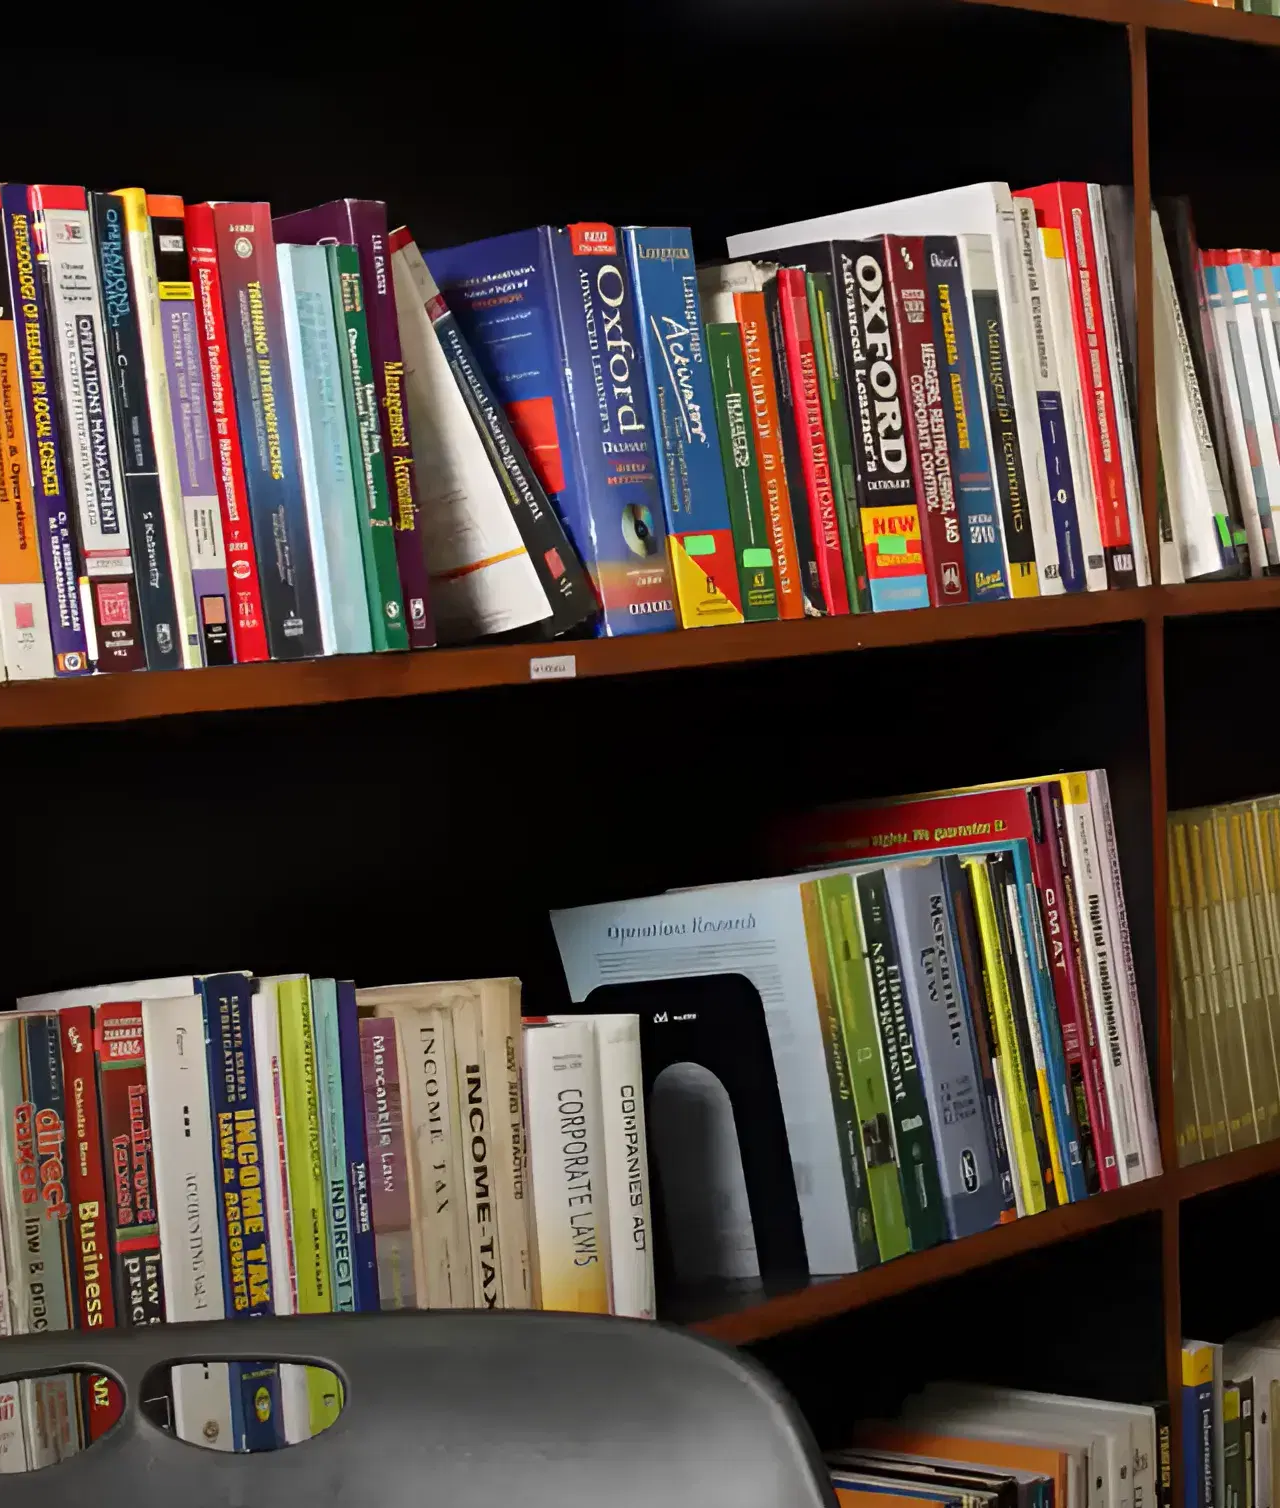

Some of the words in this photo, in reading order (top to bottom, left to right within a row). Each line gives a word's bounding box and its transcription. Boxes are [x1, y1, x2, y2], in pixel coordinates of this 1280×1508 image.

[596, 264, 646, 435] Oxford
[681, 275, 703, 363] Language
[840, 254, 866, 363] Advanced
[855, 254, 907, 474] OXFORD
[382, 361, 409, 447] Management
[92, 419, 118, 532] MANAGEMENT
[921, 452, 940, 513] CONTROL
[419, 1027, 445, 1144] INCOME
[13, 1101, 39, 1205] taxes
[35, 1108, 72, 1222] direct
[234, 1109, 265, 1235] INCOME
[380, 1152, 396, 1192] Law
[557, 1088, 593, 1207] CORPORATE
[619, 1085, 643, 1207] COMPANIES
[633, 1216, 647, 1253] ACT
[77, 1200, 105, 1327] Business
[246, 1243, 271, 1307] TAX
[330, 1179, 352, 1288] INDIRECT
[570, 1212, 599, 1267] LAWS
